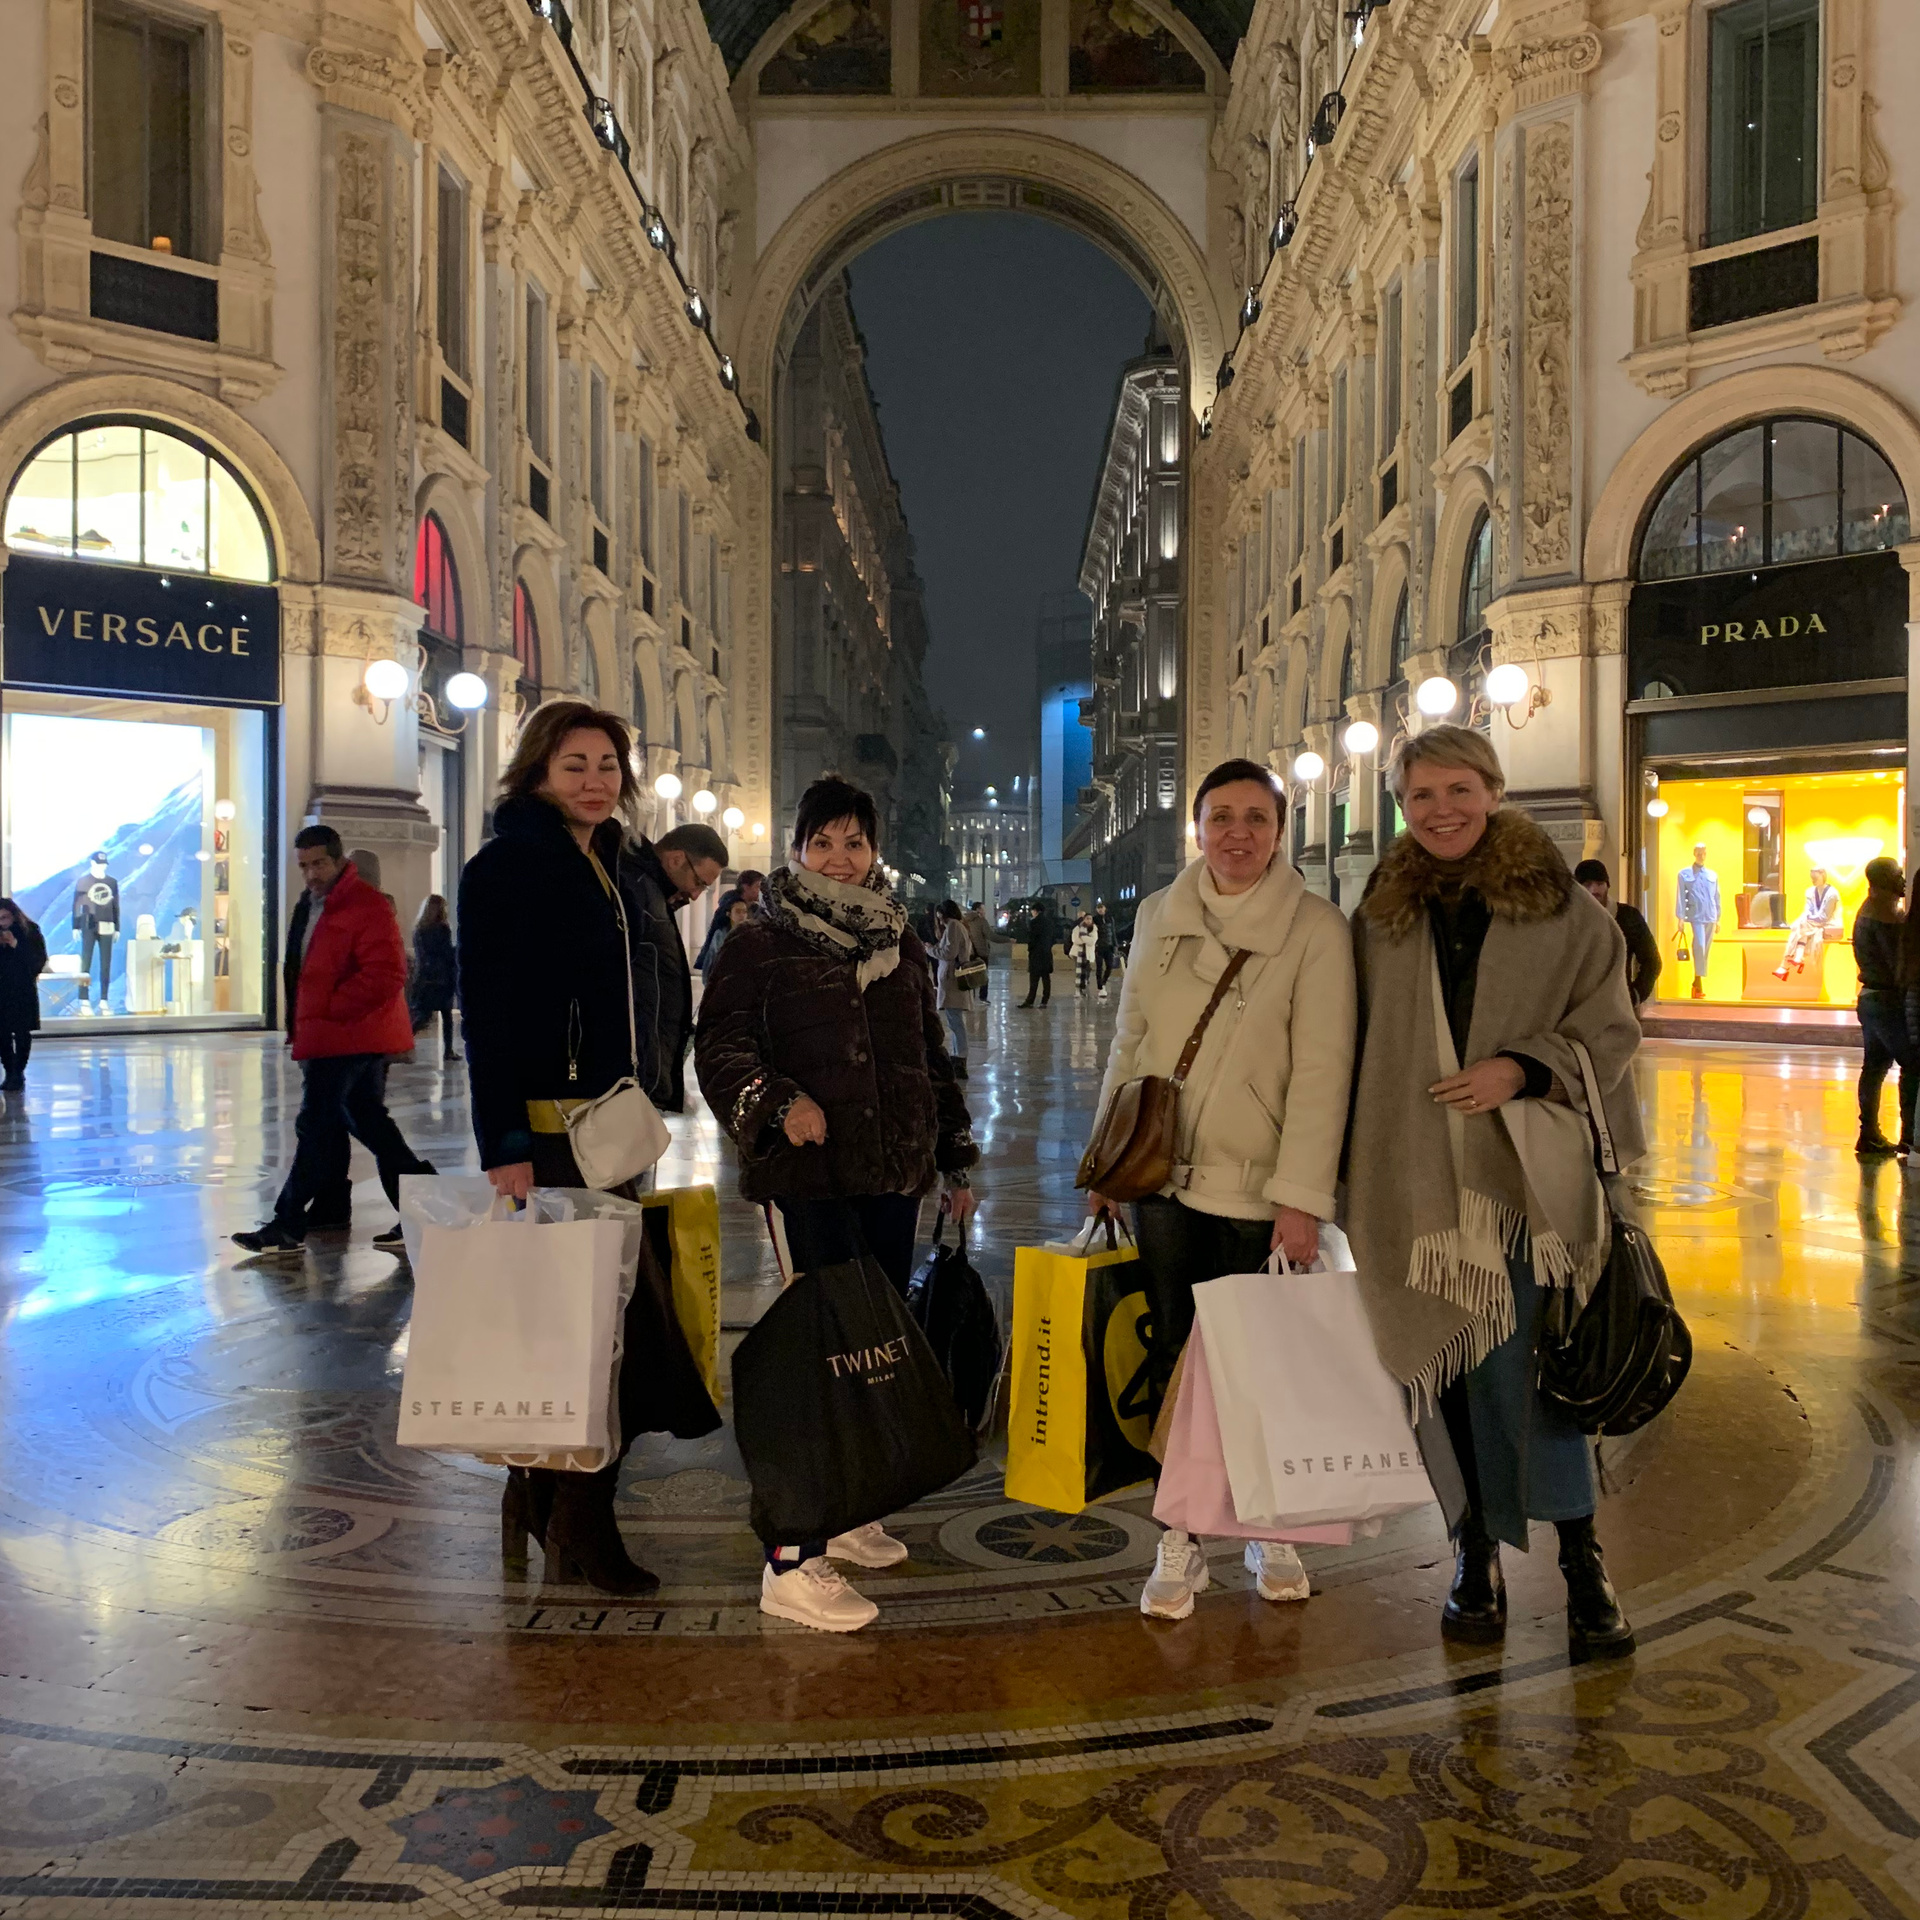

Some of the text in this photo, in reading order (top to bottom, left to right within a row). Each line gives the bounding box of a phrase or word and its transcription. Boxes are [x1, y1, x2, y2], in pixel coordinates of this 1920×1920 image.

[38, 605, 250, 657] VERSACE
[1700, 612, 1828, 646] PRADA
[1031, 1315, 1052, 1447] intrend.it
[411, 1400, 577, 1417] STEFANEL
[506, 1608, 721, 1632] FERT
